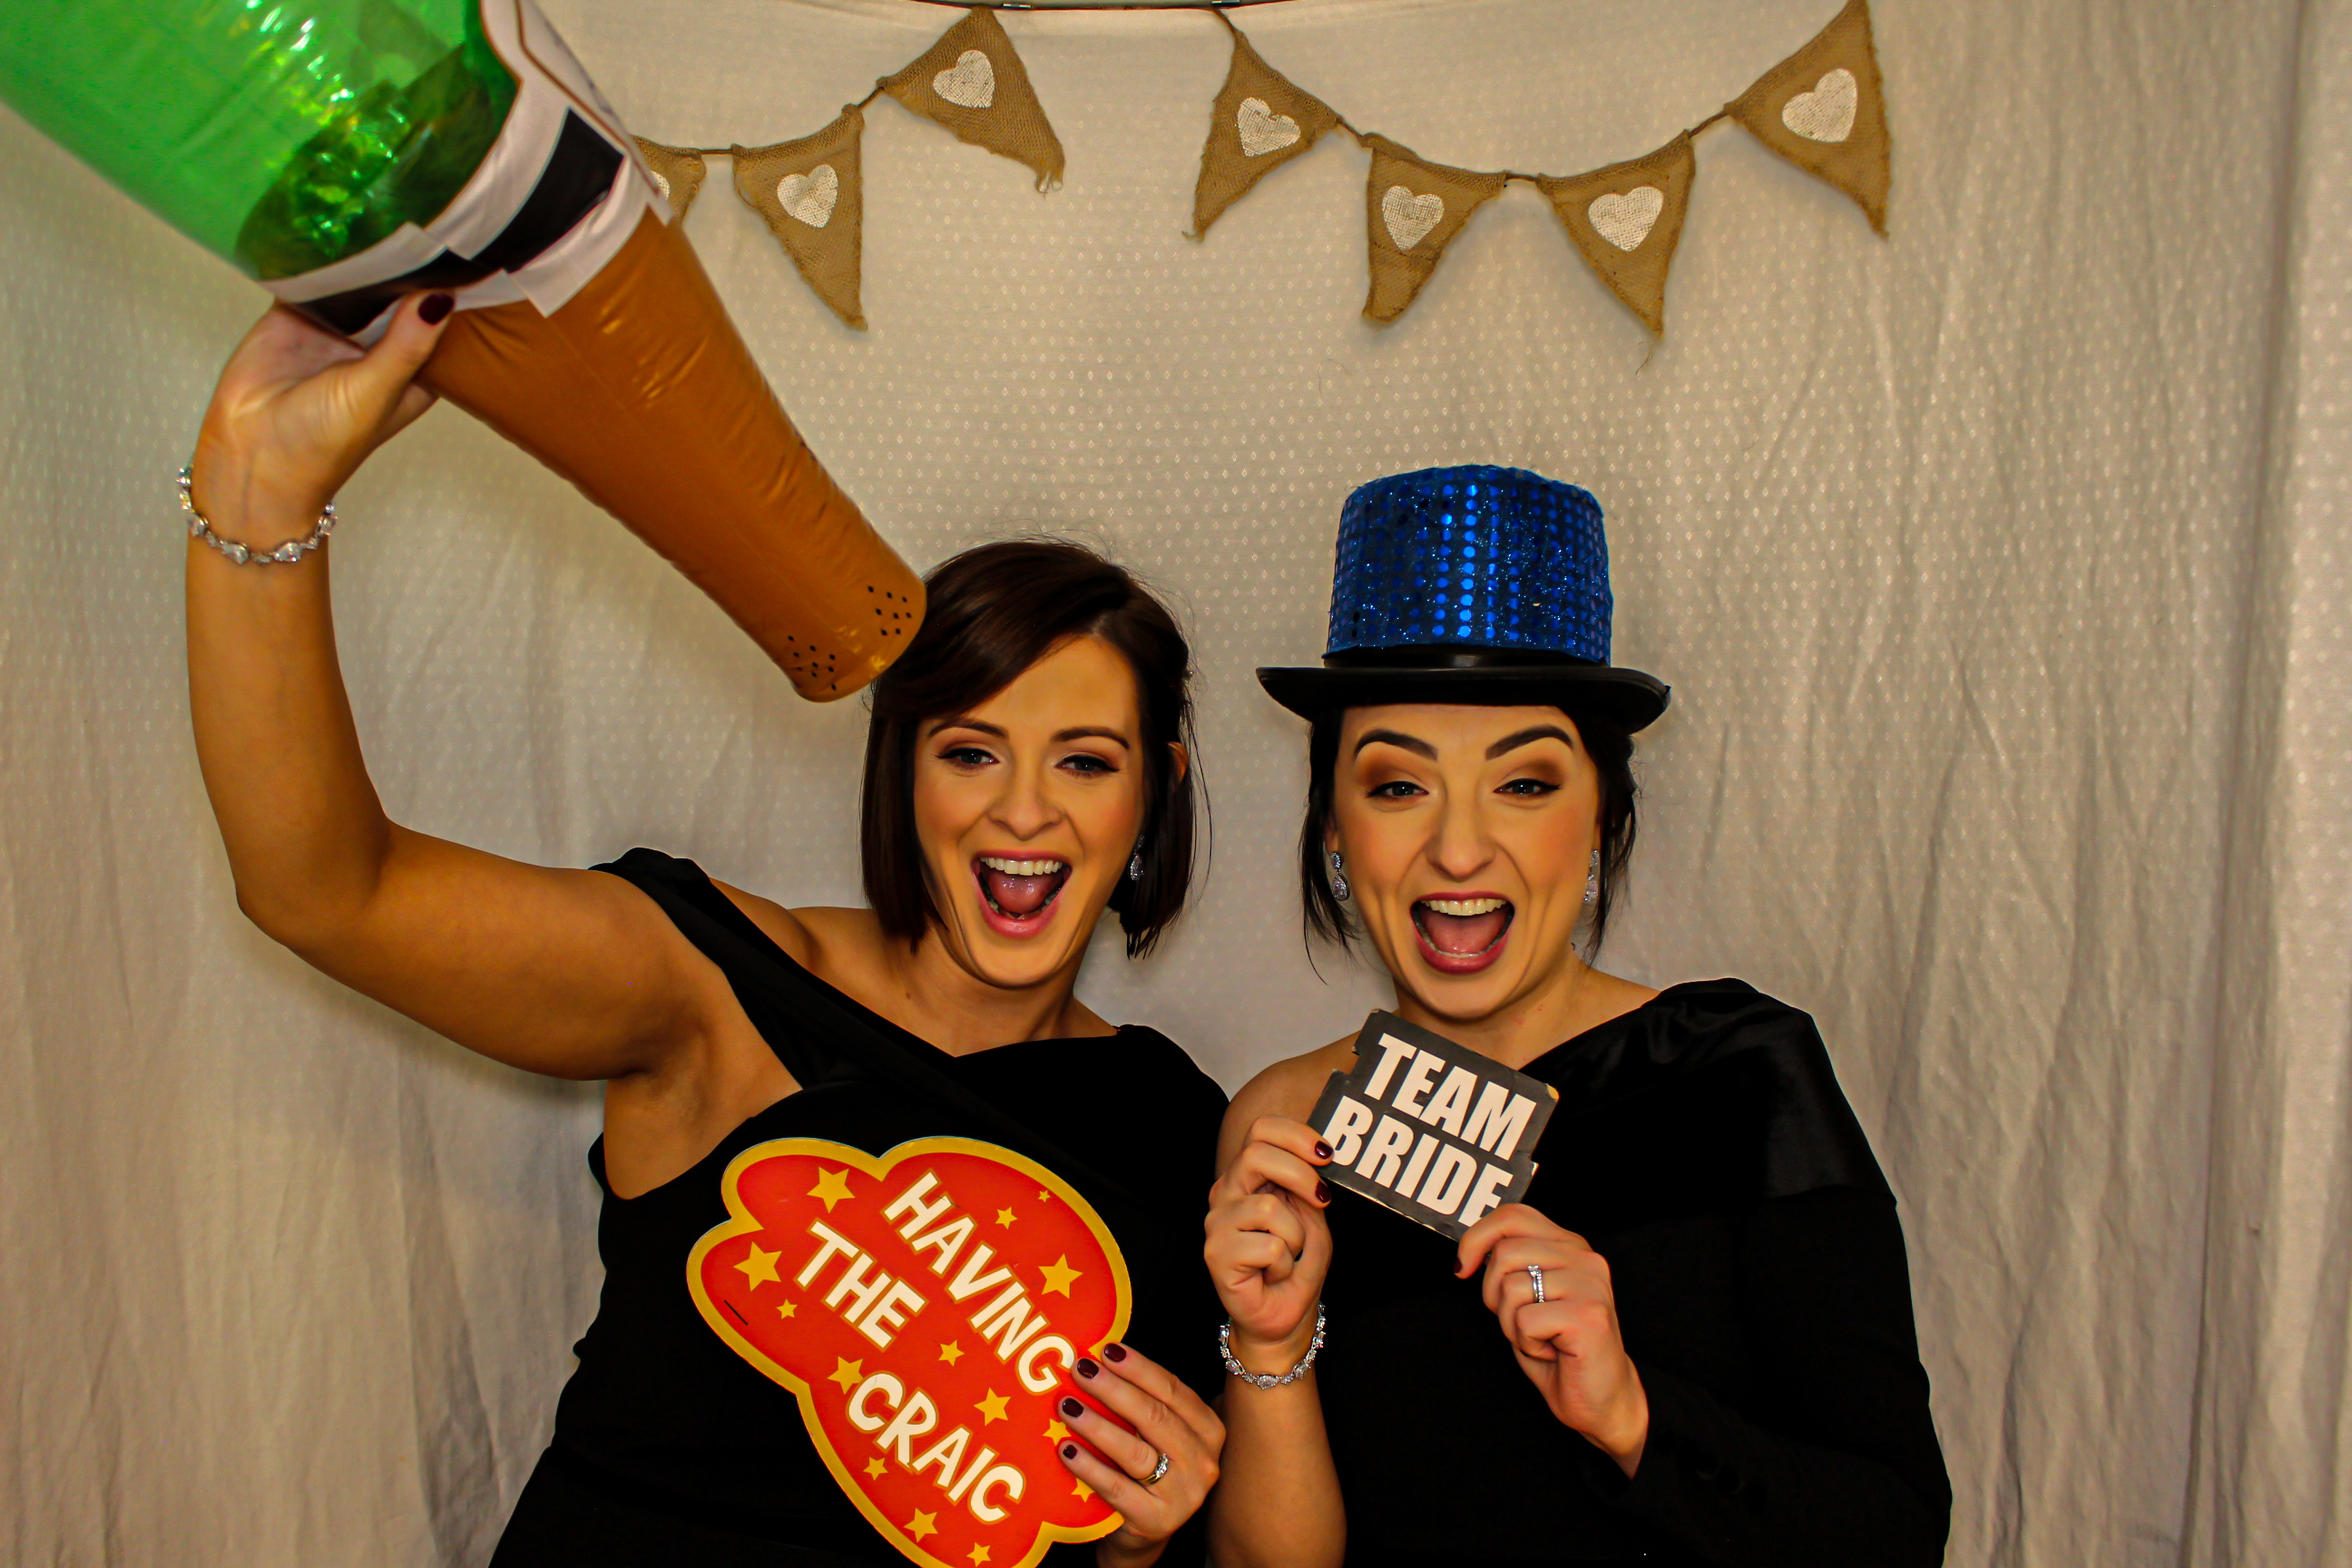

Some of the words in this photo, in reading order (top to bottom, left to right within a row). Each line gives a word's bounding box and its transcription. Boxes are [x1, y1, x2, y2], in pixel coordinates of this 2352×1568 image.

[1321, 1095, 1514, 1228] BRIDE
[1364, 1033, 1537, 1161] TEAM
[795, 1220, 926, 1349] THE
[883, 1171, 1075, 1394] HAVING
[847, 1373, 1025, 1523] CRAIC
